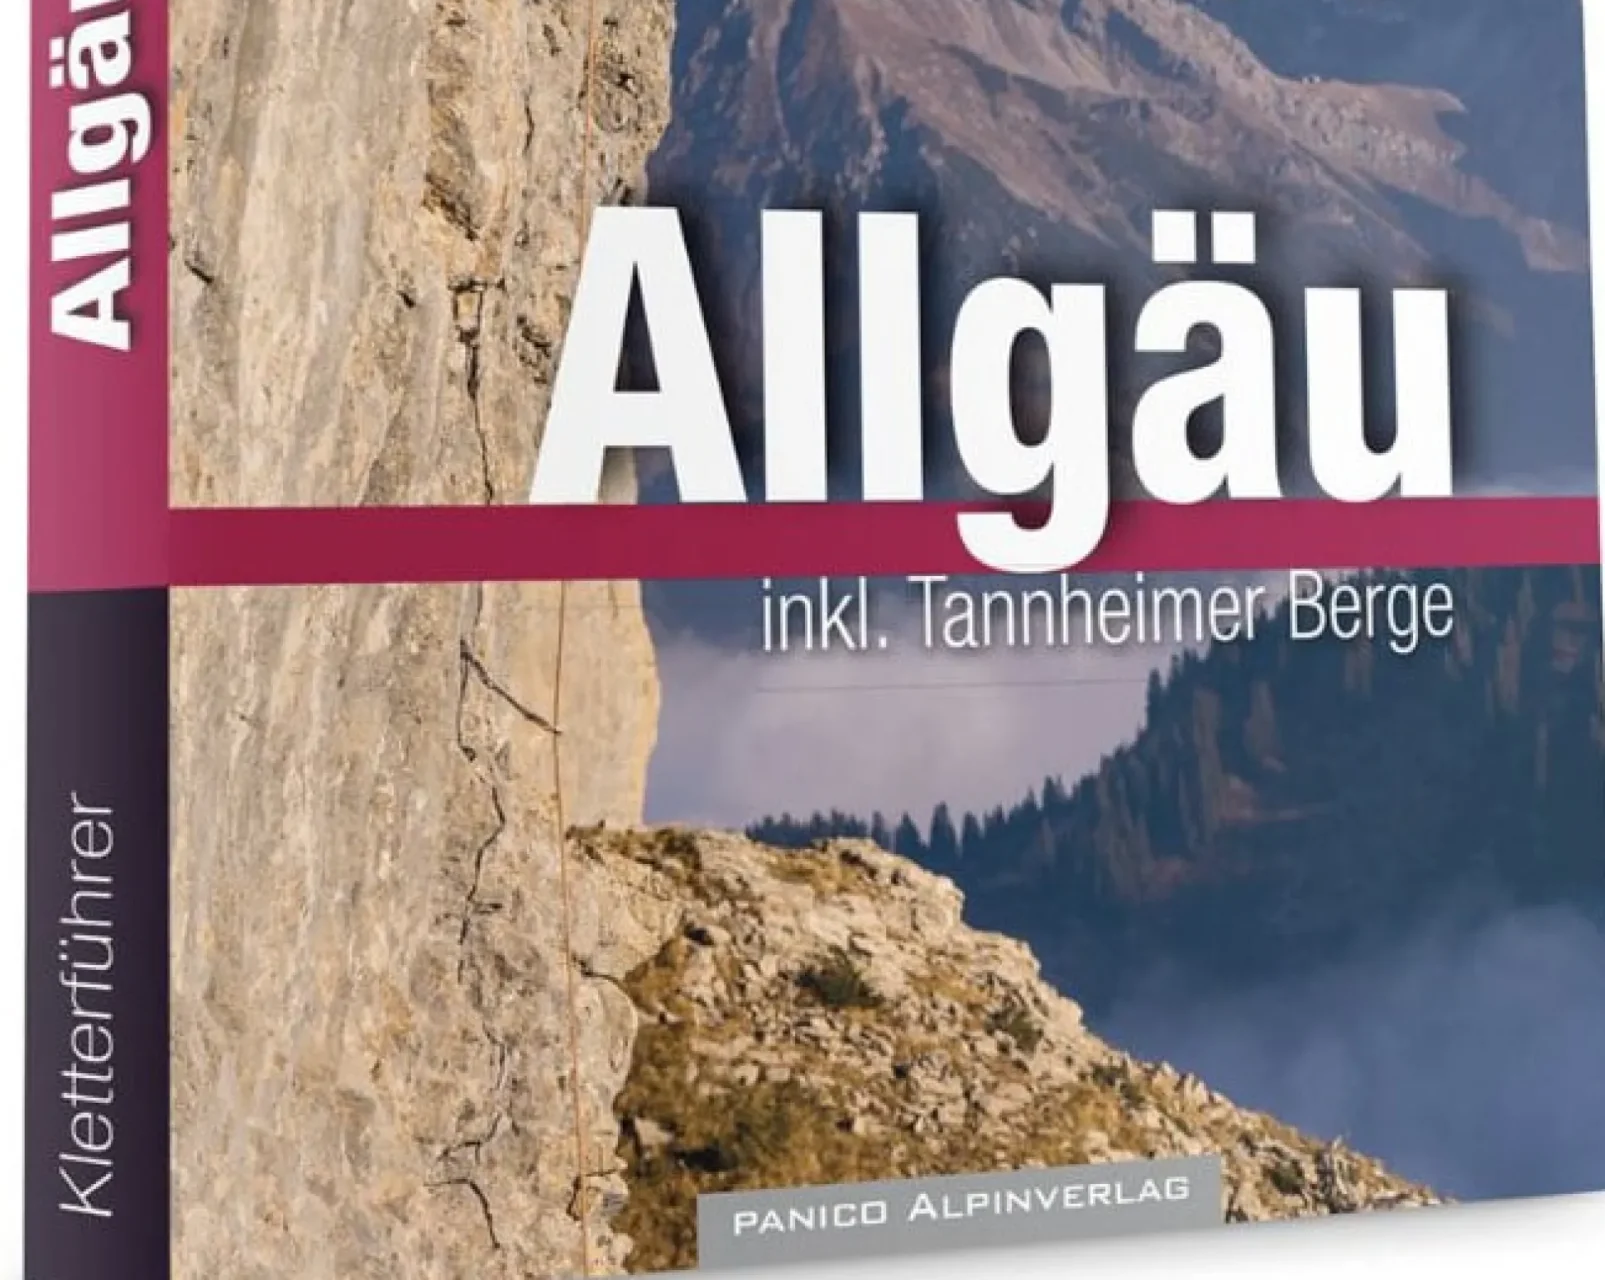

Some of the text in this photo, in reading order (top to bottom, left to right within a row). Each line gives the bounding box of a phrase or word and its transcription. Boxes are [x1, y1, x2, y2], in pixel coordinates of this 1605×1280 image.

[527, 205, 1454, 573] Allgäu
[761, 570, 1455, 654] inkl. Tannheimer Berge
[58, 790, 114, 1218] Kletterführer
[732, 1176, 1191, 1236] PANICO ALPINVERLAG
